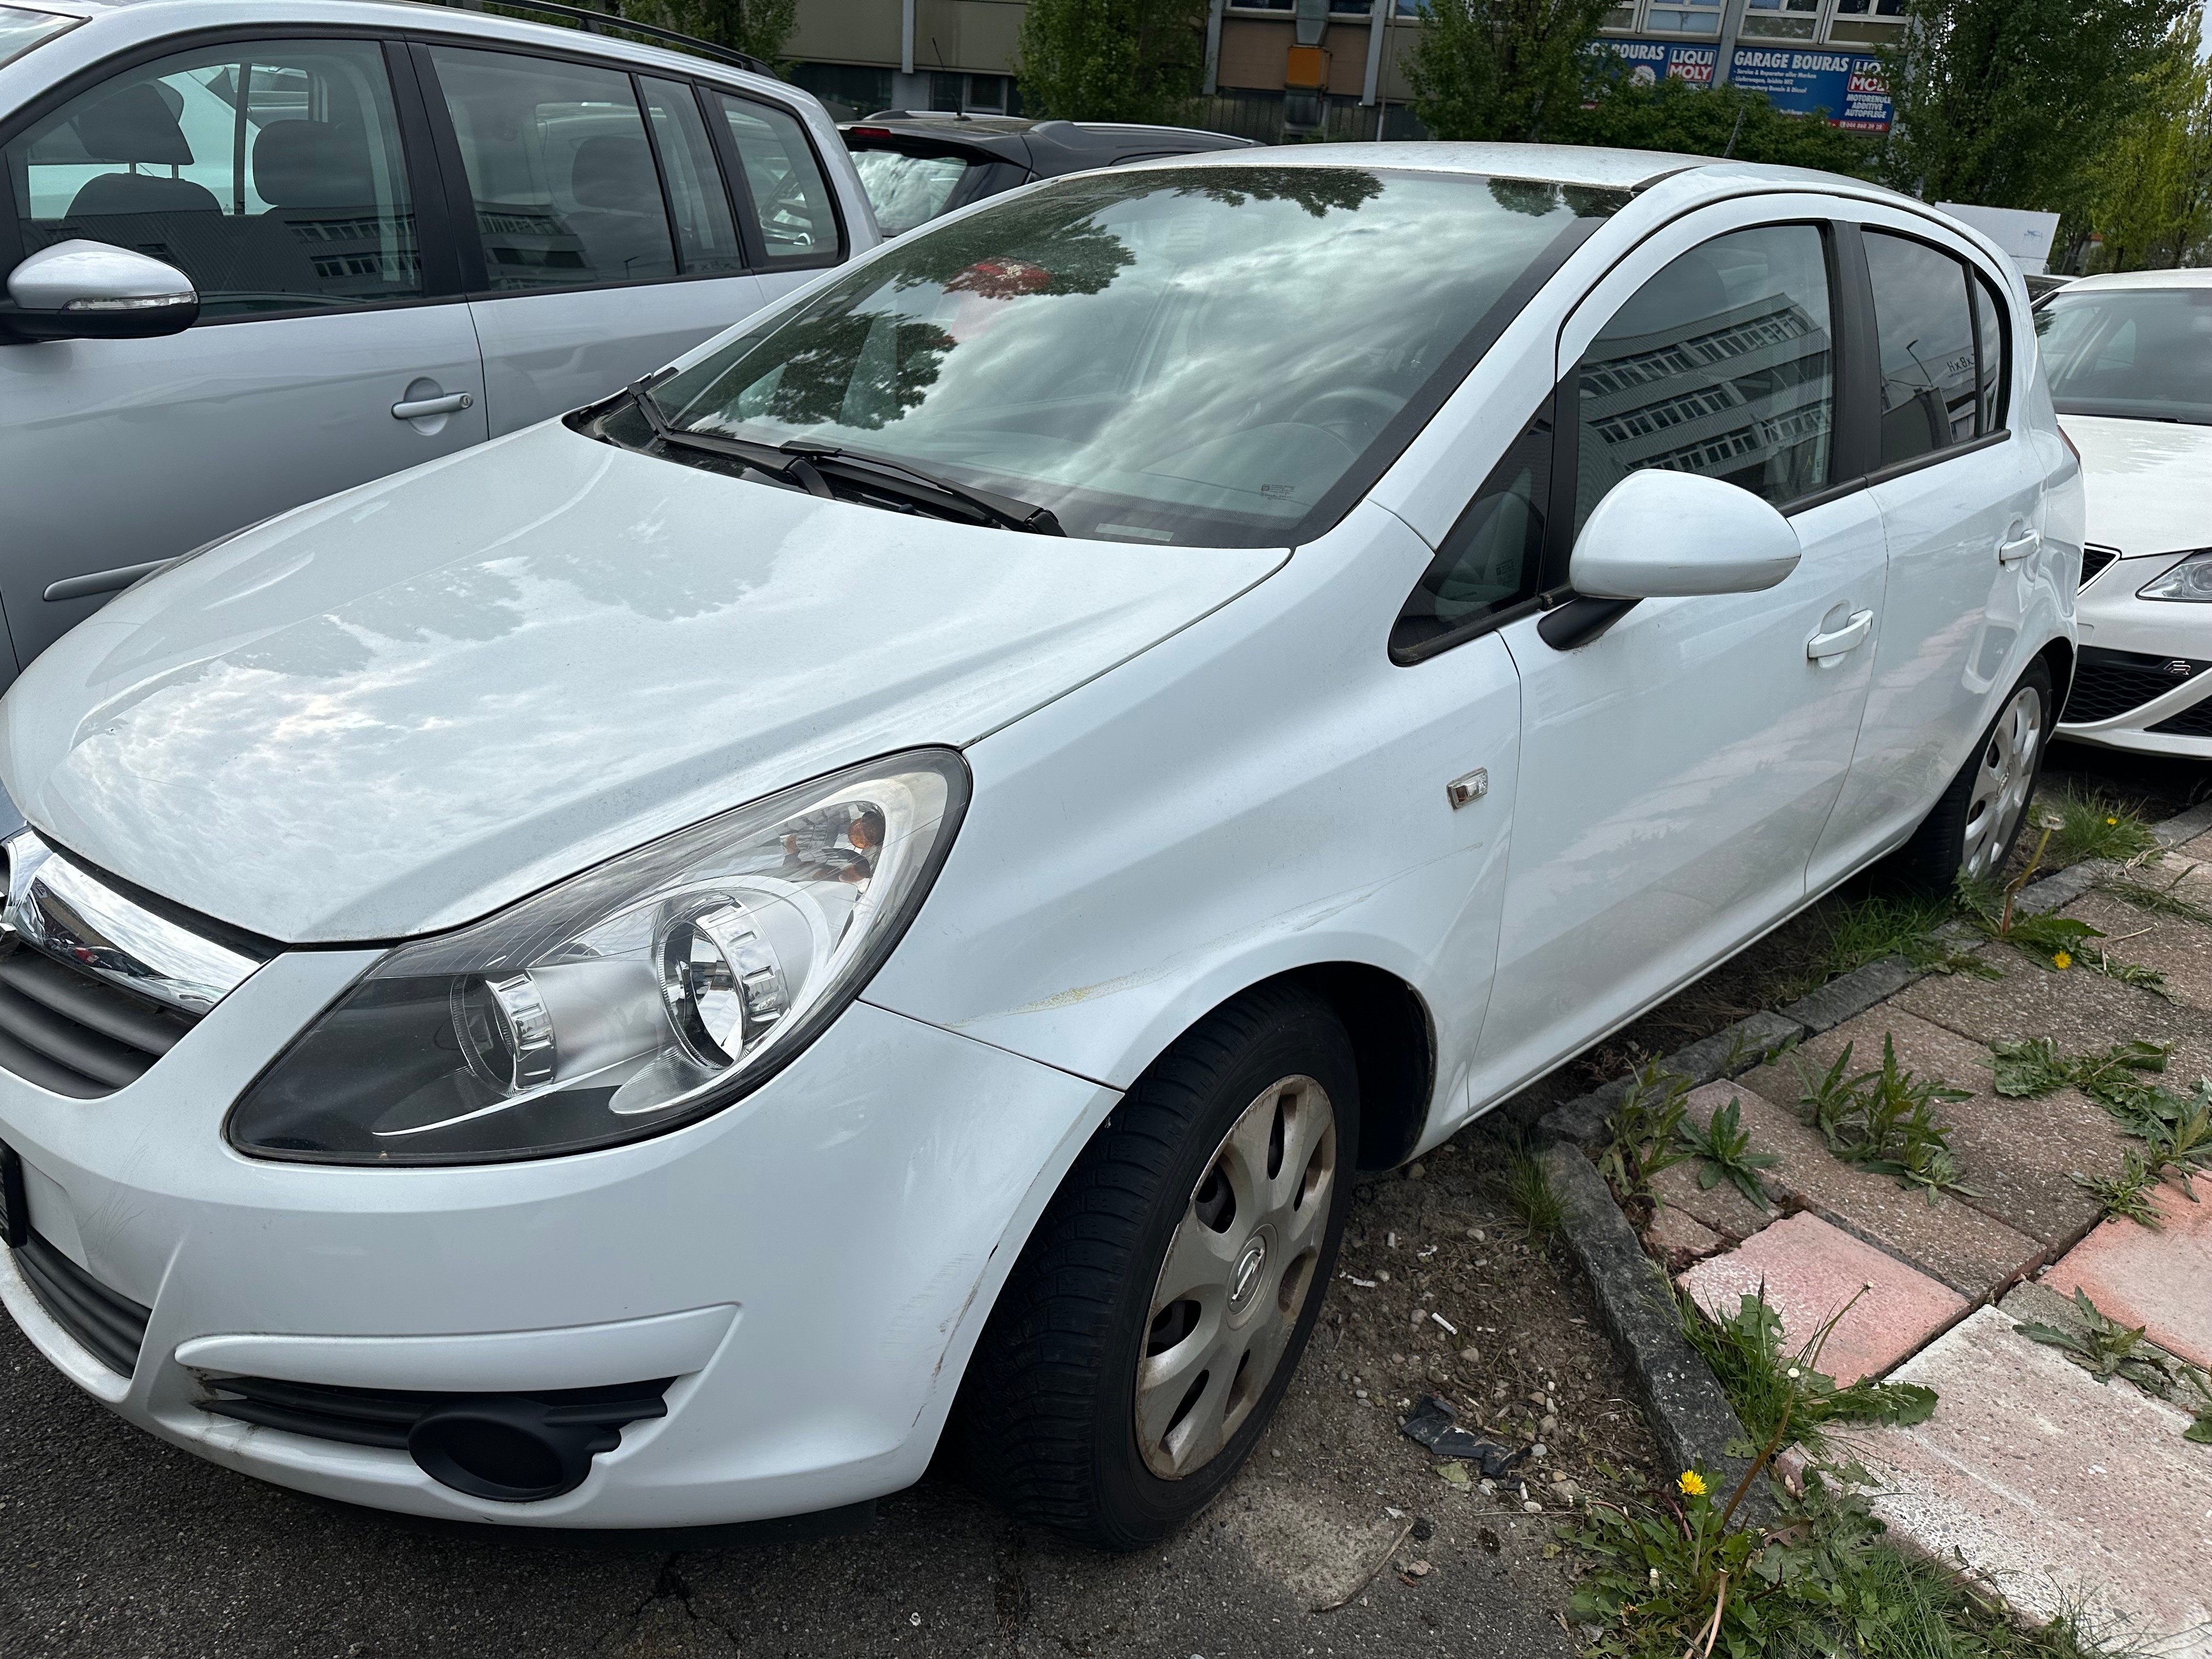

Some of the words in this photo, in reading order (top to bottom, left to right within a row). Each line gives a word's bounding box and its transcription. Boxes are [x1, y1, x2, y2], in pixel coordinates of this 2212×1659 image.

[1672, 50, 1713, 65] LIQUI
[1734, 51, 1789, 69] GARAGE
[1792, 54, 1849, 72] BOURAS
[1668, 65, 1712, 80] MOLY
[1844, 109, 1887, 119] AUTOPFLEGE
